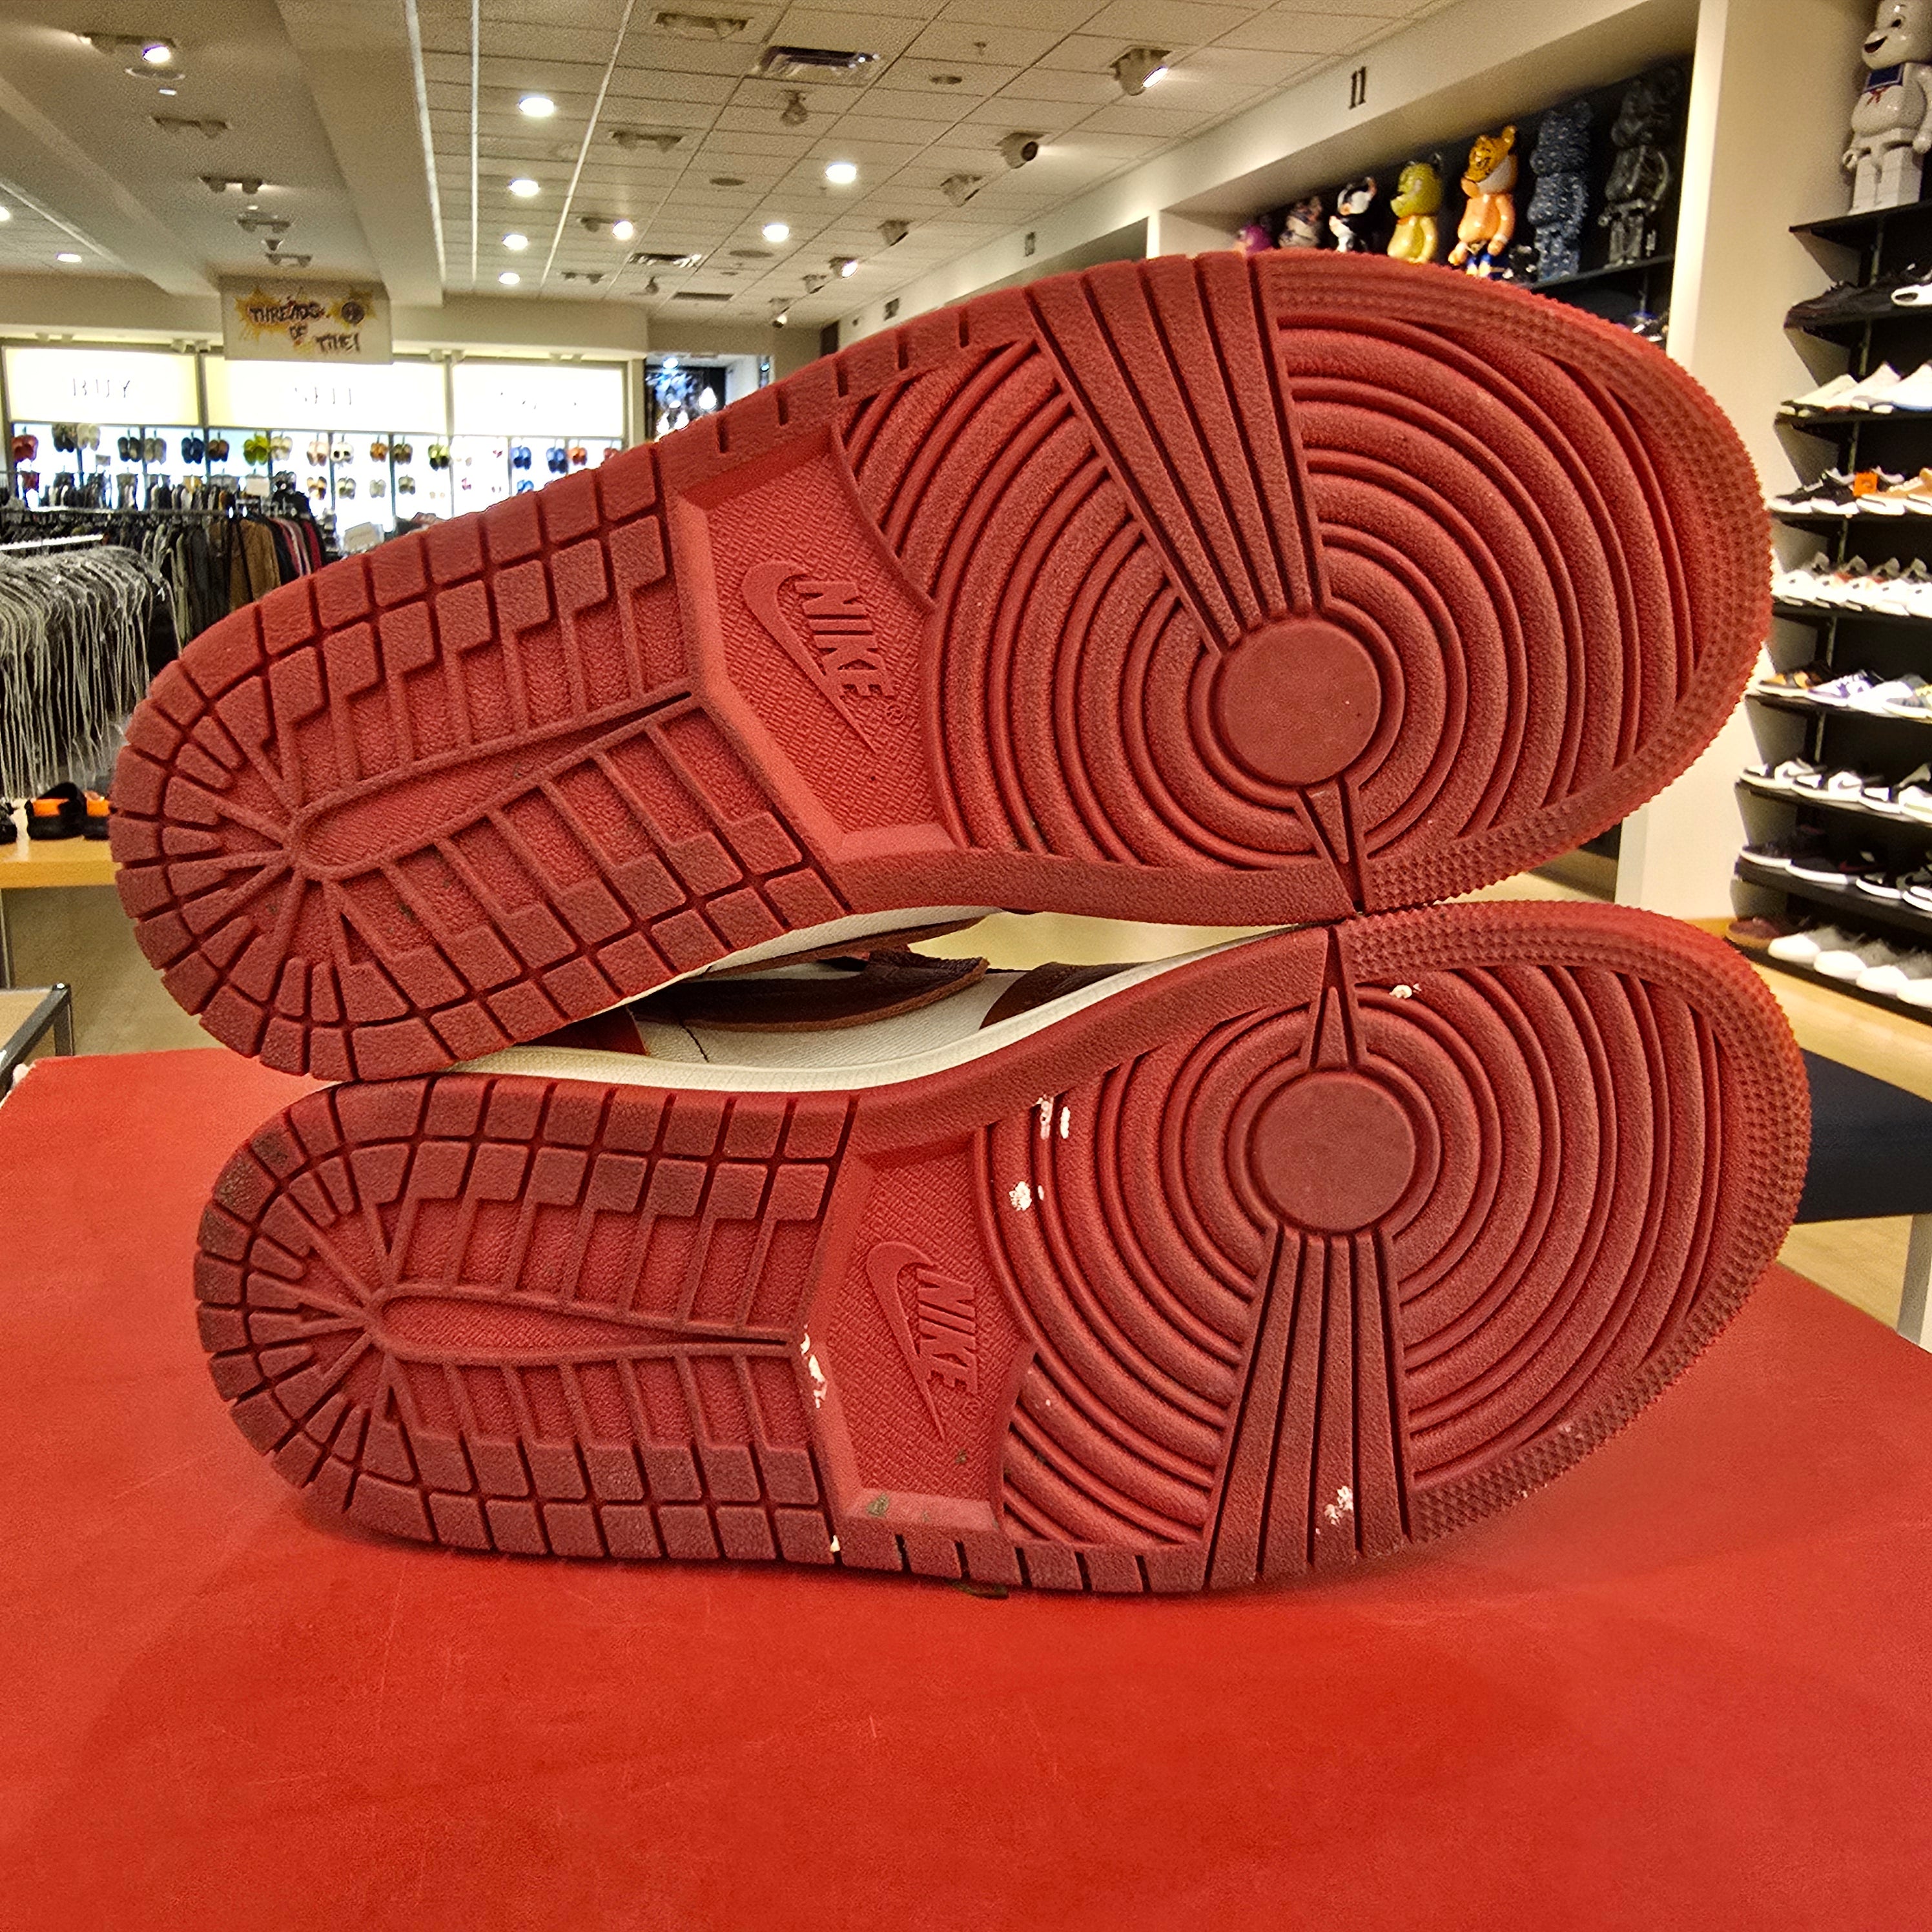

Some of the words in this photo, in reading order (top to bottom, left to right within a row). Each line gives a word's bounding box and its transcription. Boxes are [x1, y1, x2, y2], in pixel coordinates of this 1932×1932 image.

[1349, 66, 1366, 110] 11
[249, 300, 325, 324] THREADS
[289, 324, 307, 340] OF
[72, 378, 131, 398] BUY
[794, 581, 896, 698] NIKE
[916, 1268, 978, 1396] NIKE
